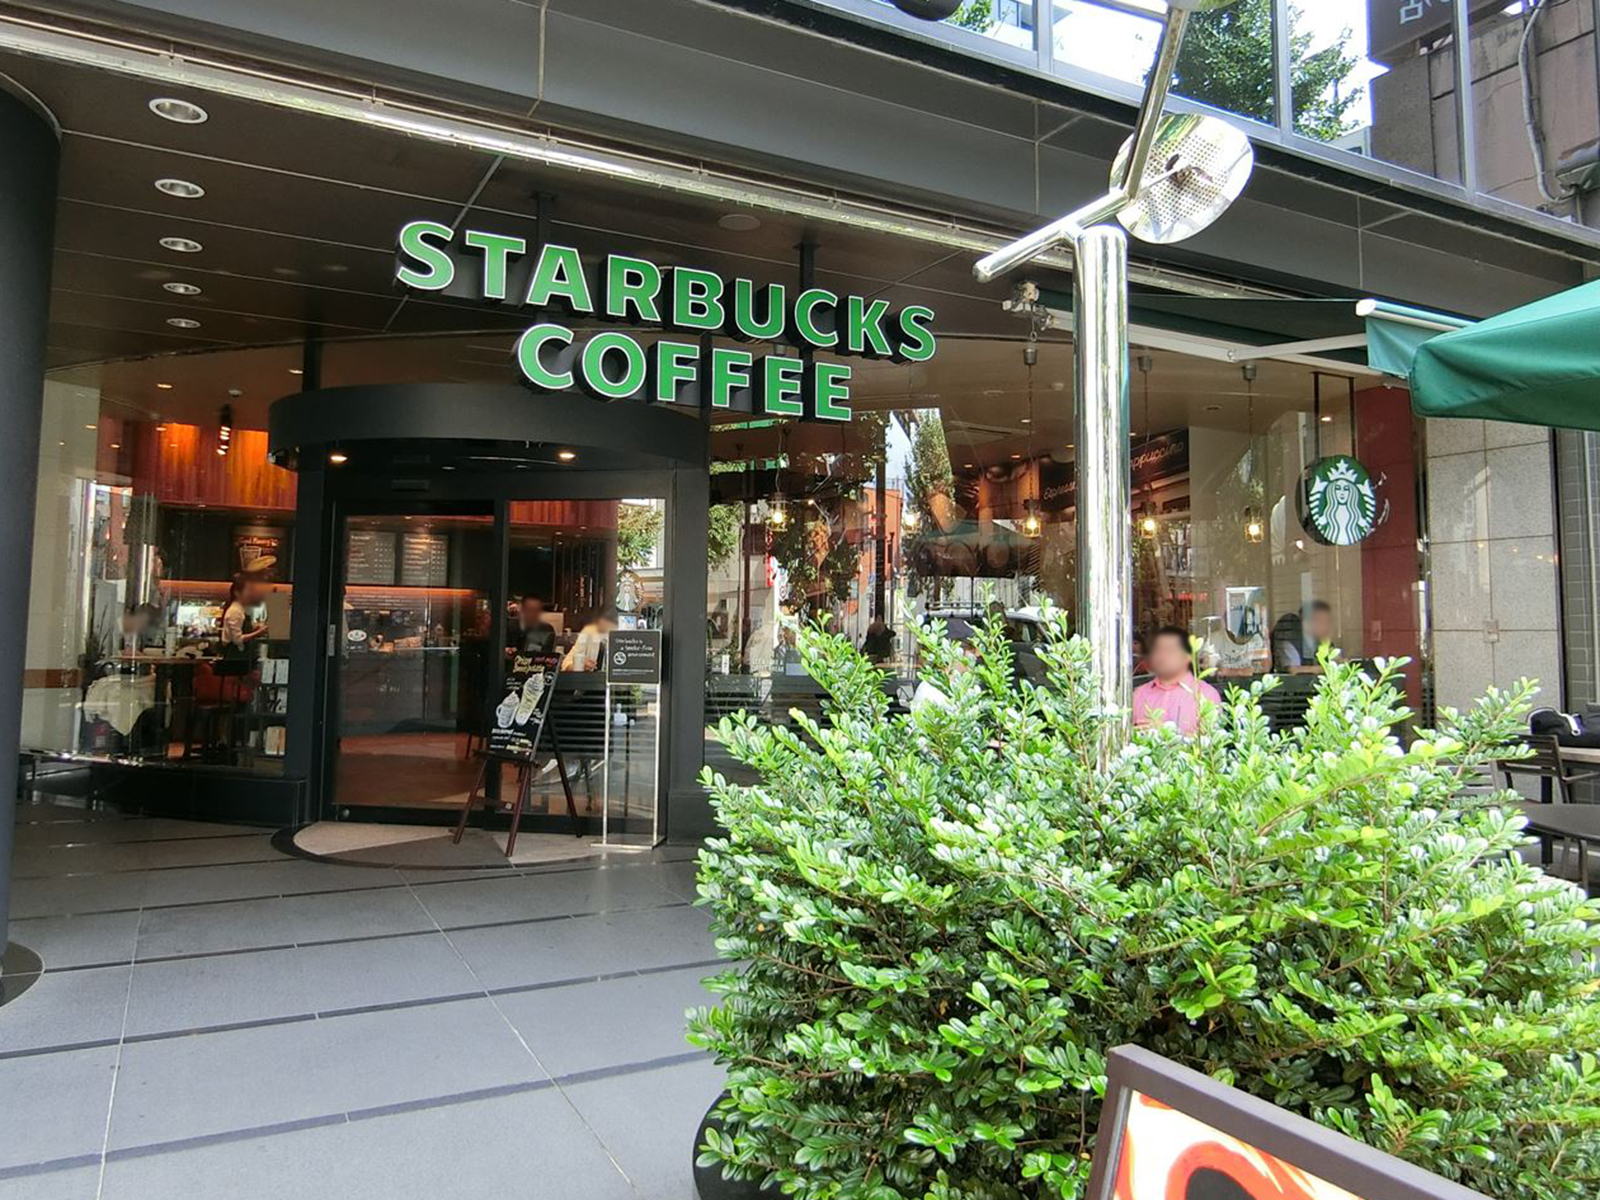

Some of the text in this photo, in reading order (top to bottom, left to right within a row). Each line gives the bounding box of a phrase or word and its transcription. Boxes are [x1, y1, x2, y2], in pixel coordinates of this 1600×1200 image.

[396, 220, 937, 362] STARBUCKS
[517, 323, 852, 422] COFFEE
[1132, 442, 1183, 470] ppuccino
